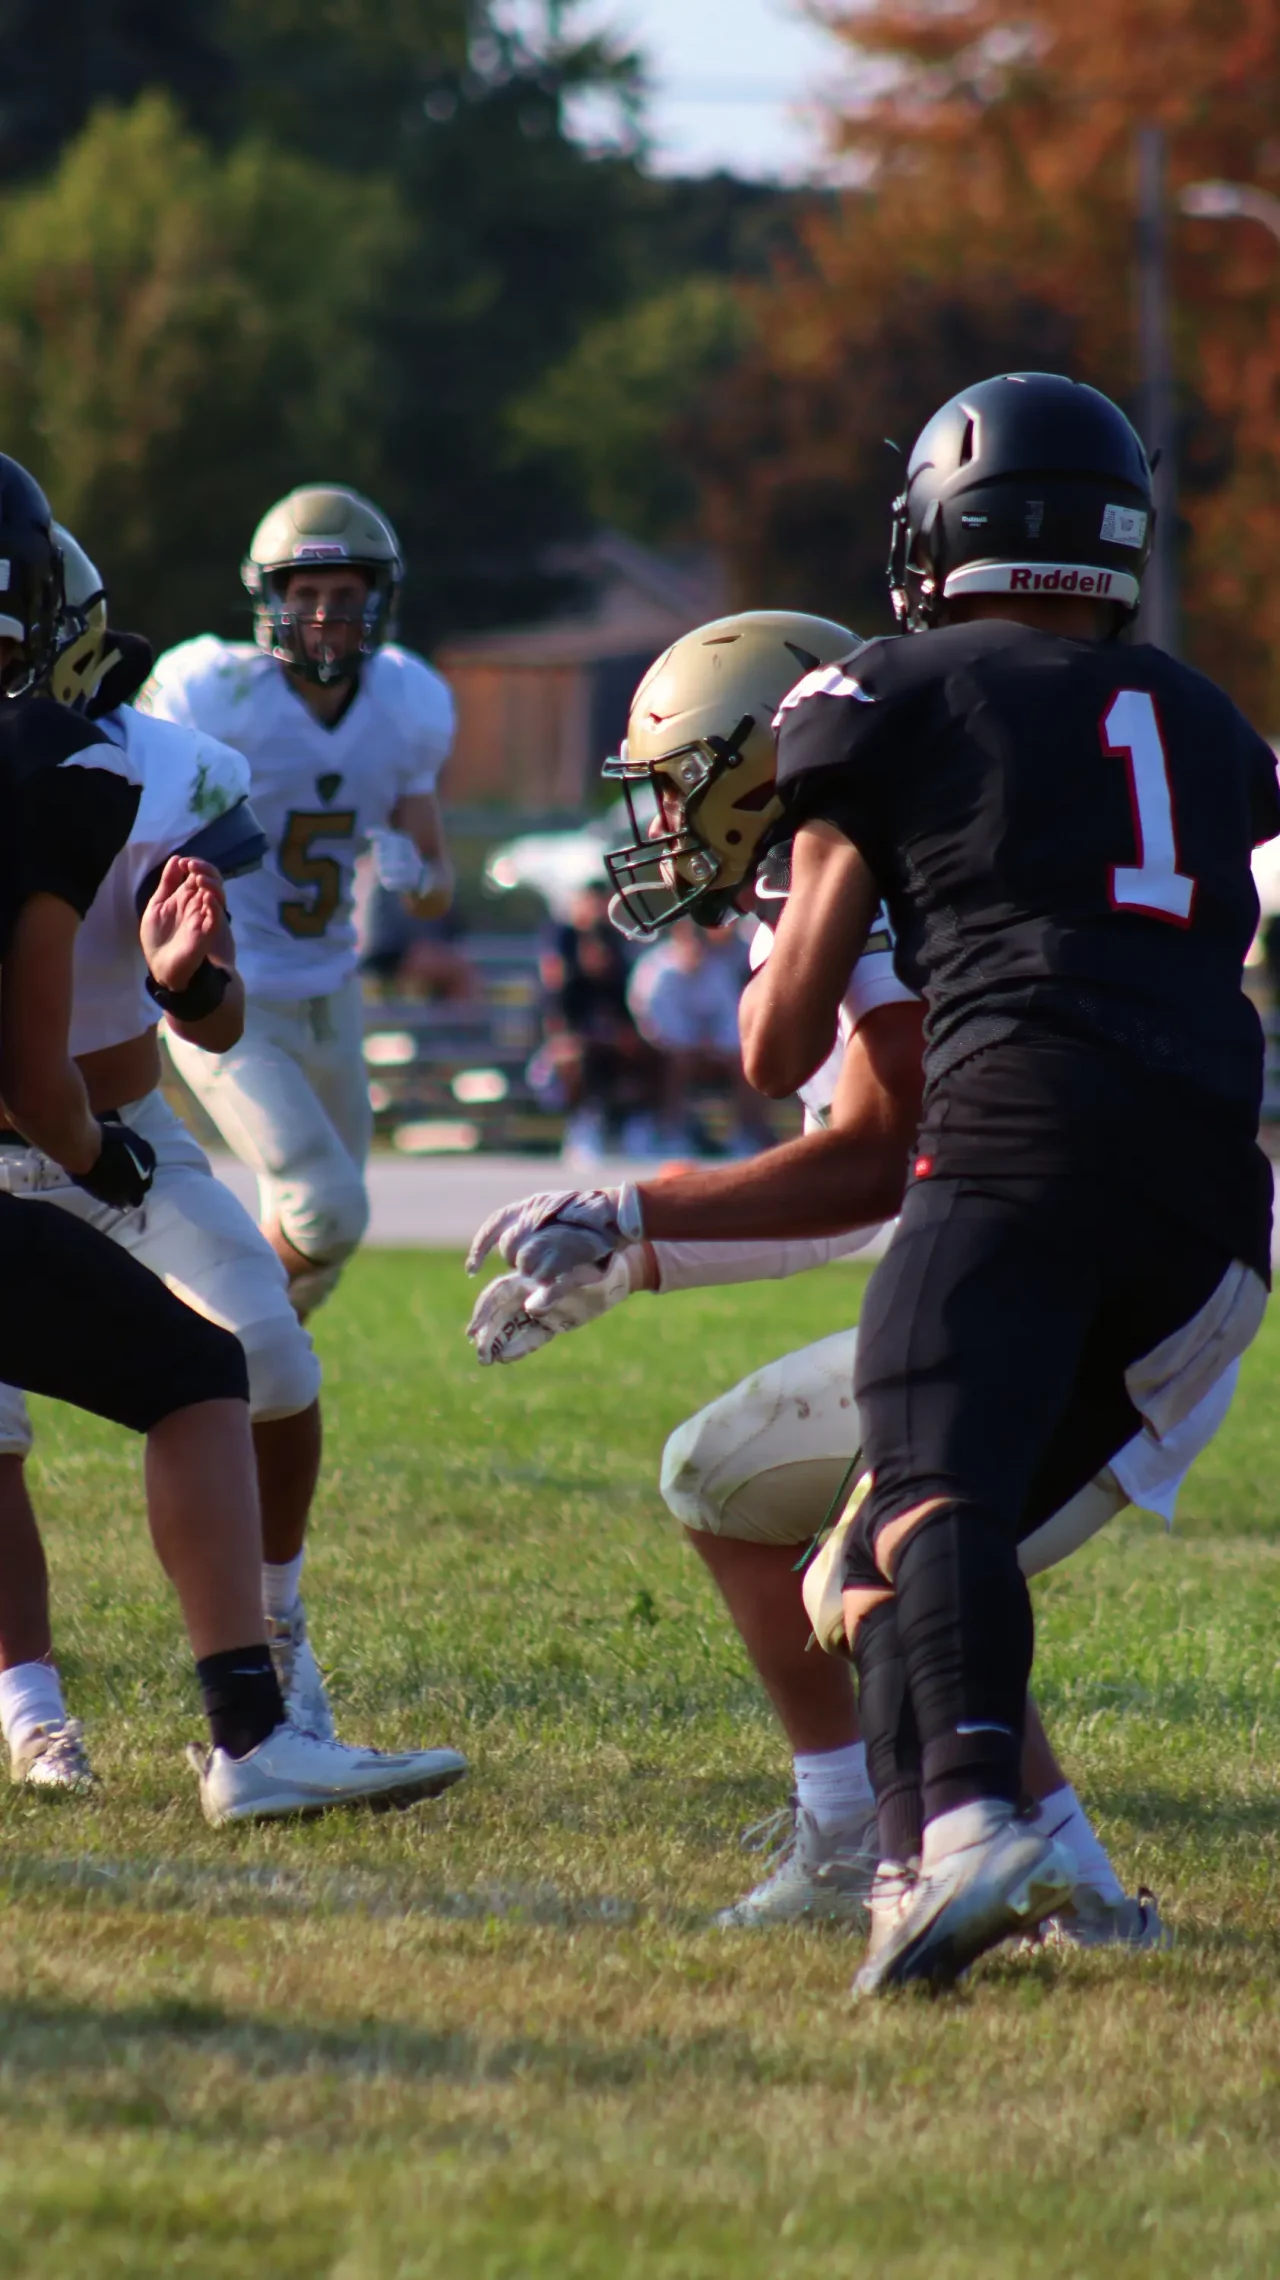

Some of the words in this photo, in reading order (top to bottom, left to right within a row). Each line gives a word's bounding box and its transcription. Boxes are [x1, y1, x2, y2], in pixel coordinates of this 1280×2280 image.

[1010, 569, 1112, 594] Riddell
[1098, 688, 1197, 930] 1
[277, 810, 357, 940] 5
